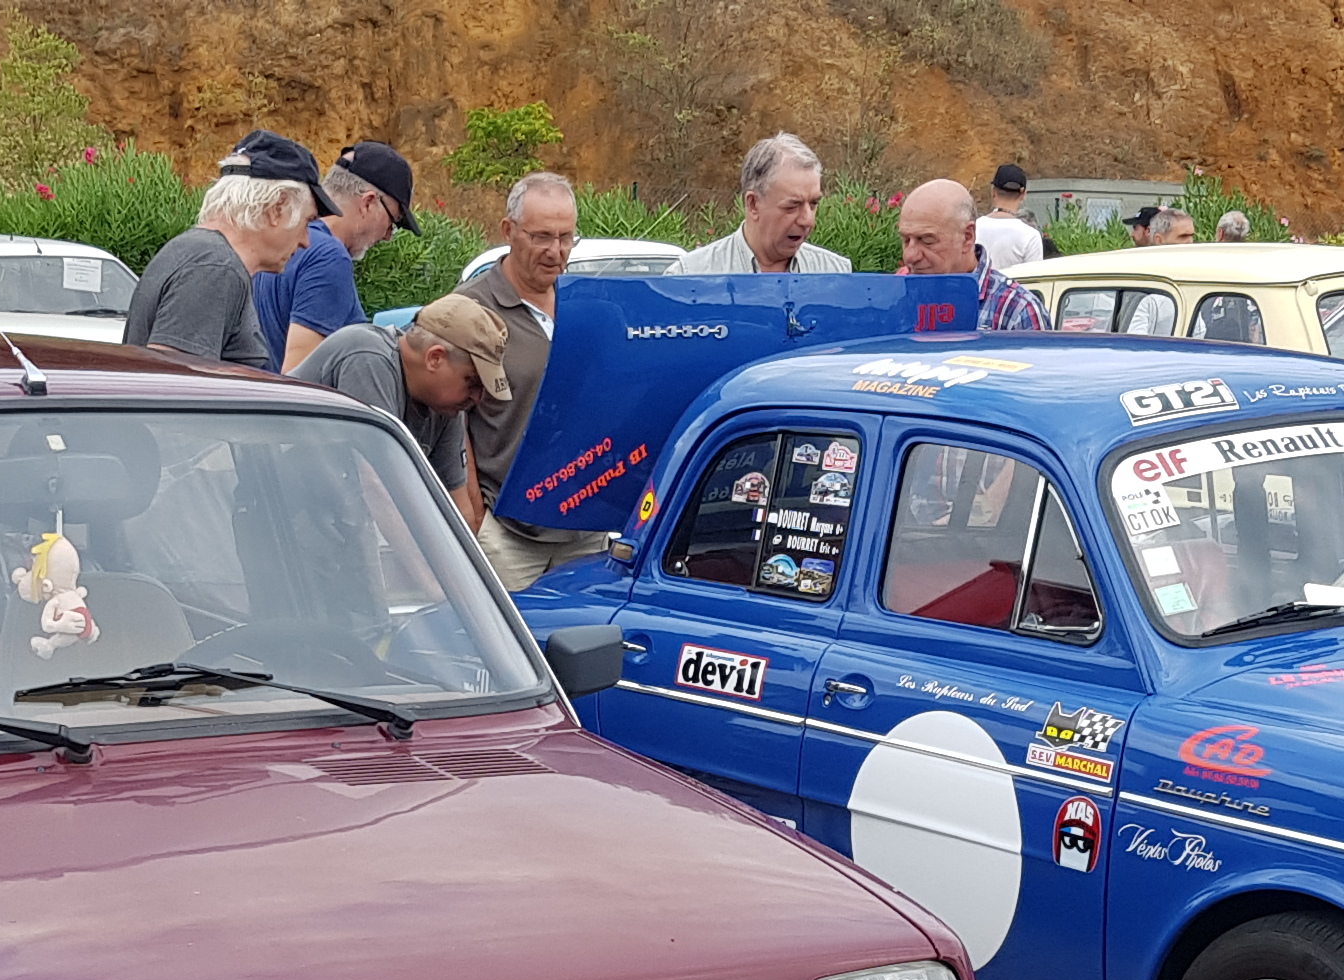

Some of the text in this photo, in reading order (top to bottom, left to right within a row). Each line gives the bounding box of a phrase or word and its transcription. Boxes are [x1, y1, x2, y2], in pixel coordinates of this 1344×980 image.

[851, 379, 941, 399] MAGAZINE
[1124, 379, 1234, 418] GT2i
[1133, 448, 1188, 482] elf
[1212, 426, 1343, 464] Renault
[682, 650, 762, 696] devil
[896, 674, 917, 690] Les
[979, 692, 998, 707] du
[1055, 753, 1108, 778] MARCHAL
[1154, 779, 1270, 817] Dauphine
[1118, 824, 1167, 861] Vénus
[1167, 827, 1222, 872] Photos
